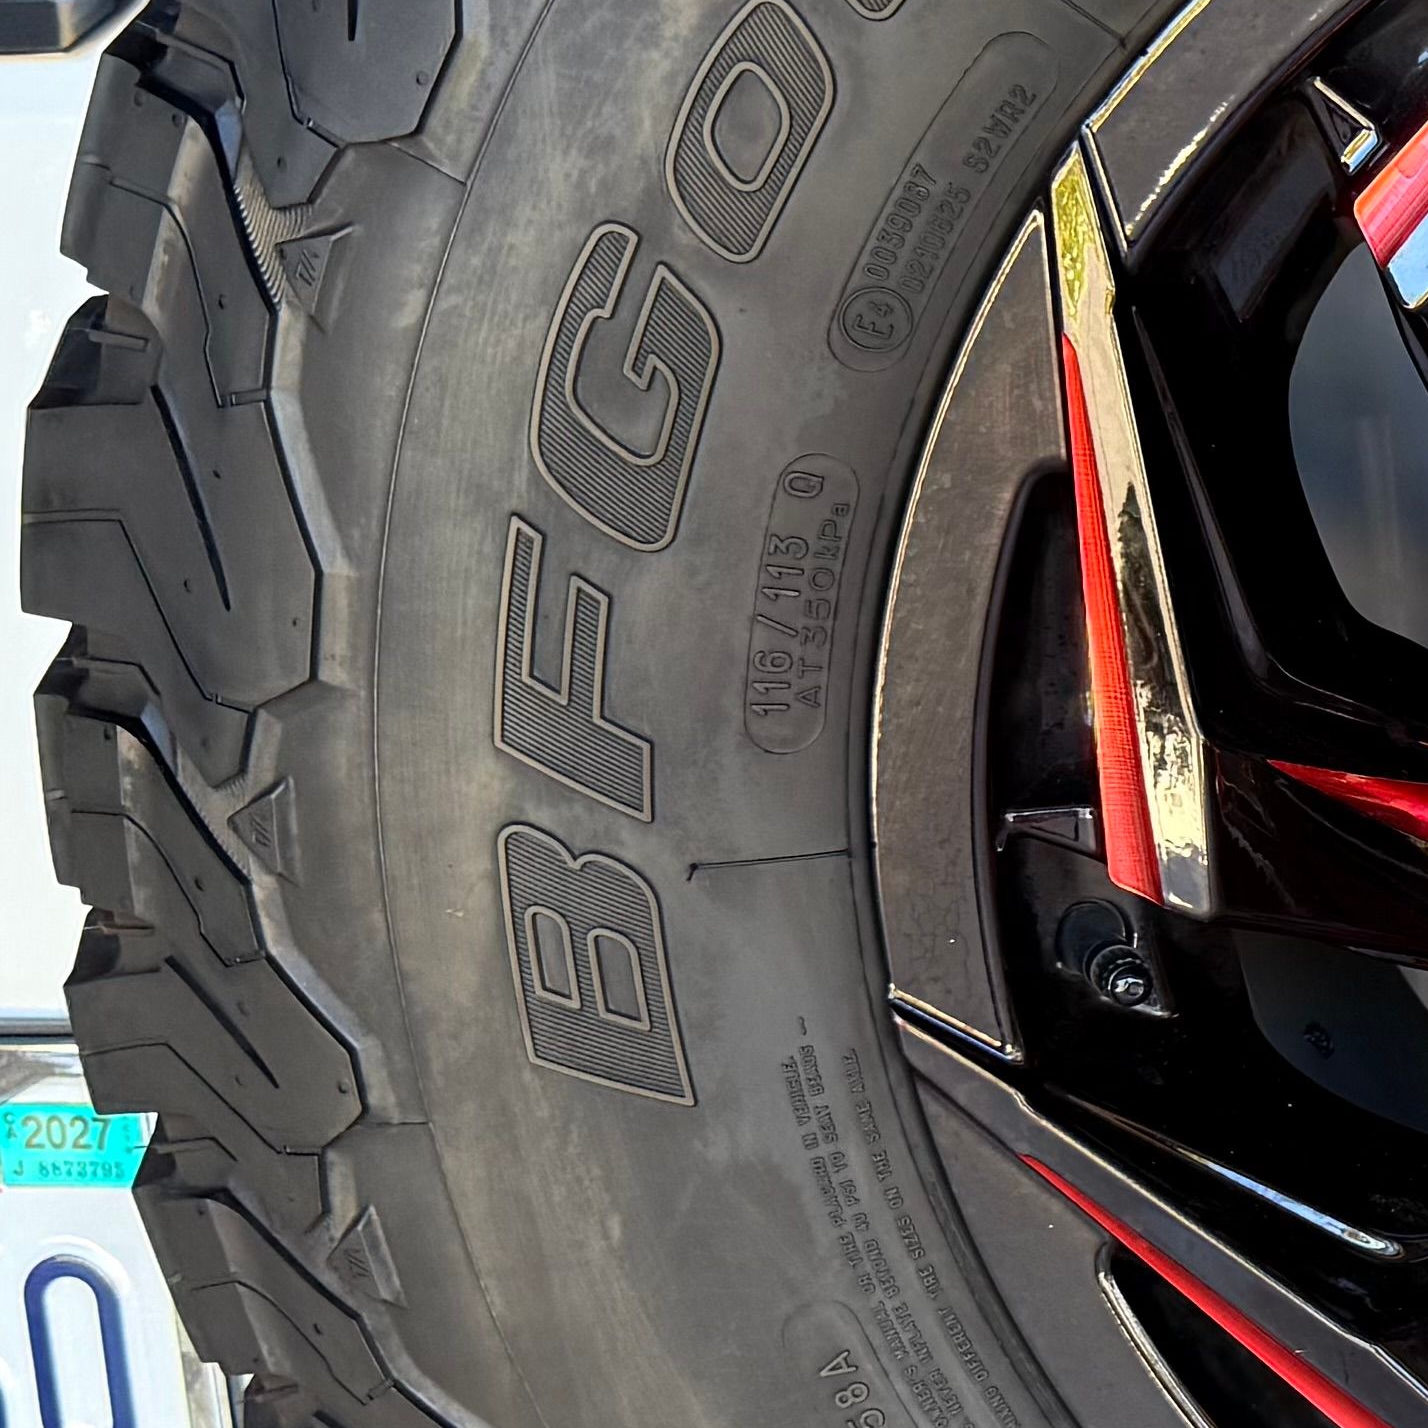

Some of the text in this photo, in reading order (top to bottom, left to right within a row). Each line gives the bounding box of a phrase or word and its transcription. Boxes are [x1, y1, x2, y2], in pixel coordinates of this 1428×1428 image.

[793, 500, 853, 708] AT 350kPa
[21, 1115, 112, 1150] 2027
